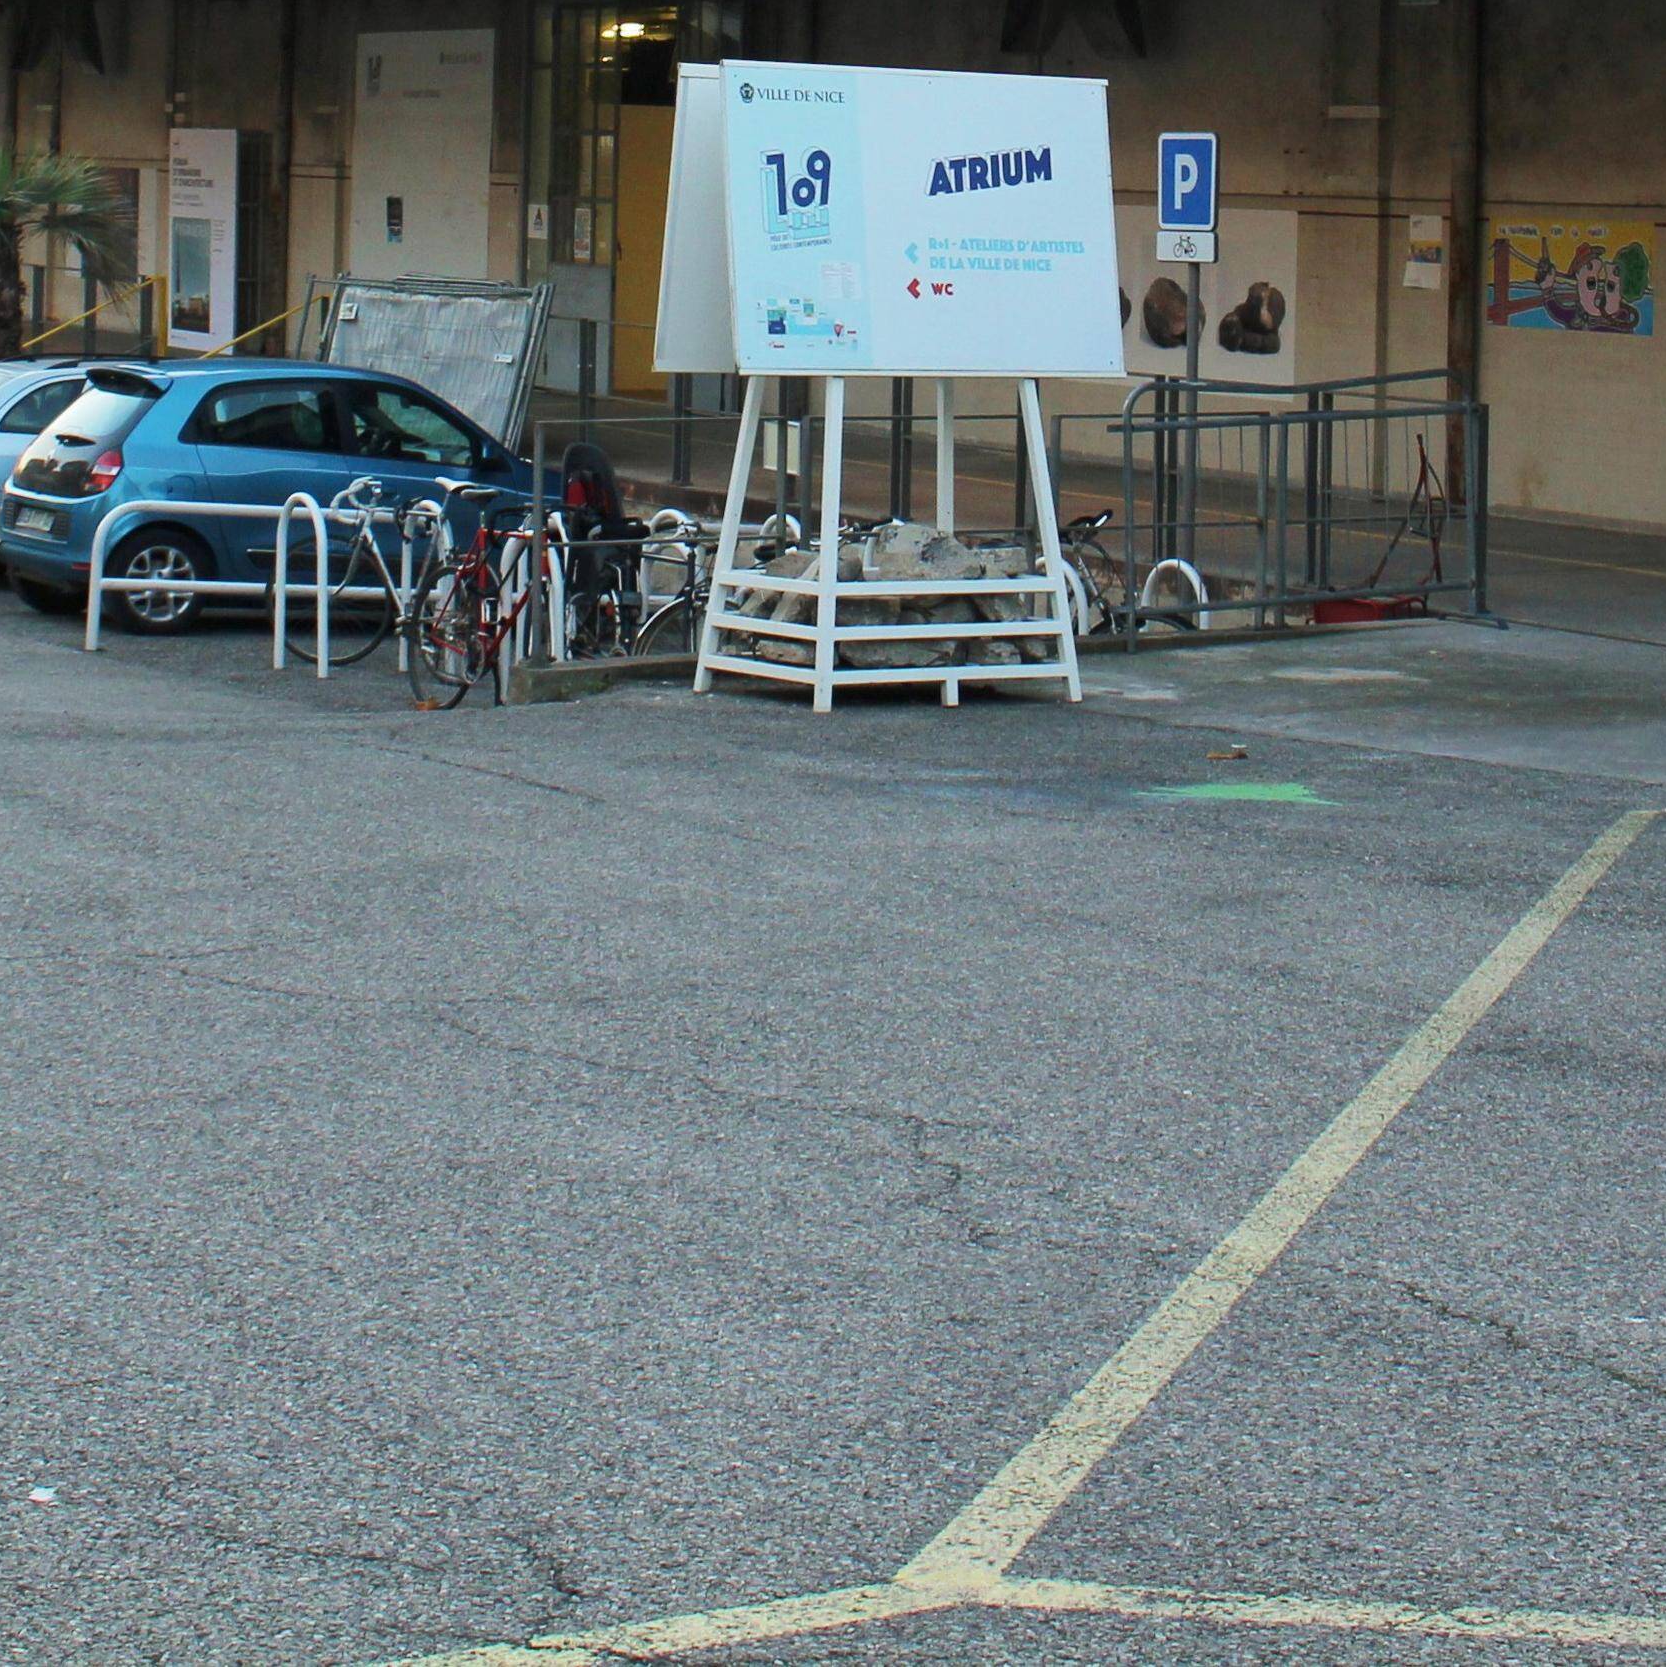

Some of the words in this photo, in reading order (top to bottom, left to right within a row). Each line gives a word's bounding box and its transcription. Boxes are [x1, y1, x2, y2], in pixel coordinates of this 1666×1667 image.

[757, 88, 790, 101] VILLE
[794, 89, 811, 102] DE
[814, 91, 846, 104] NICE
[928, 146, 1053, 196] ATRIUM
[1174, 153, 1198, 210] P
[959, 238, 1014, 252] ATELIERS
[930, 257, 946, 270] DE
[949, 257, 964, 270] LA
[969, 257, 1002, 271] VILLE
[1004, 258, 1020, 271] DE
[1022, 259, 1052, 272] NICE
[930, 282, 954, 296] WC
